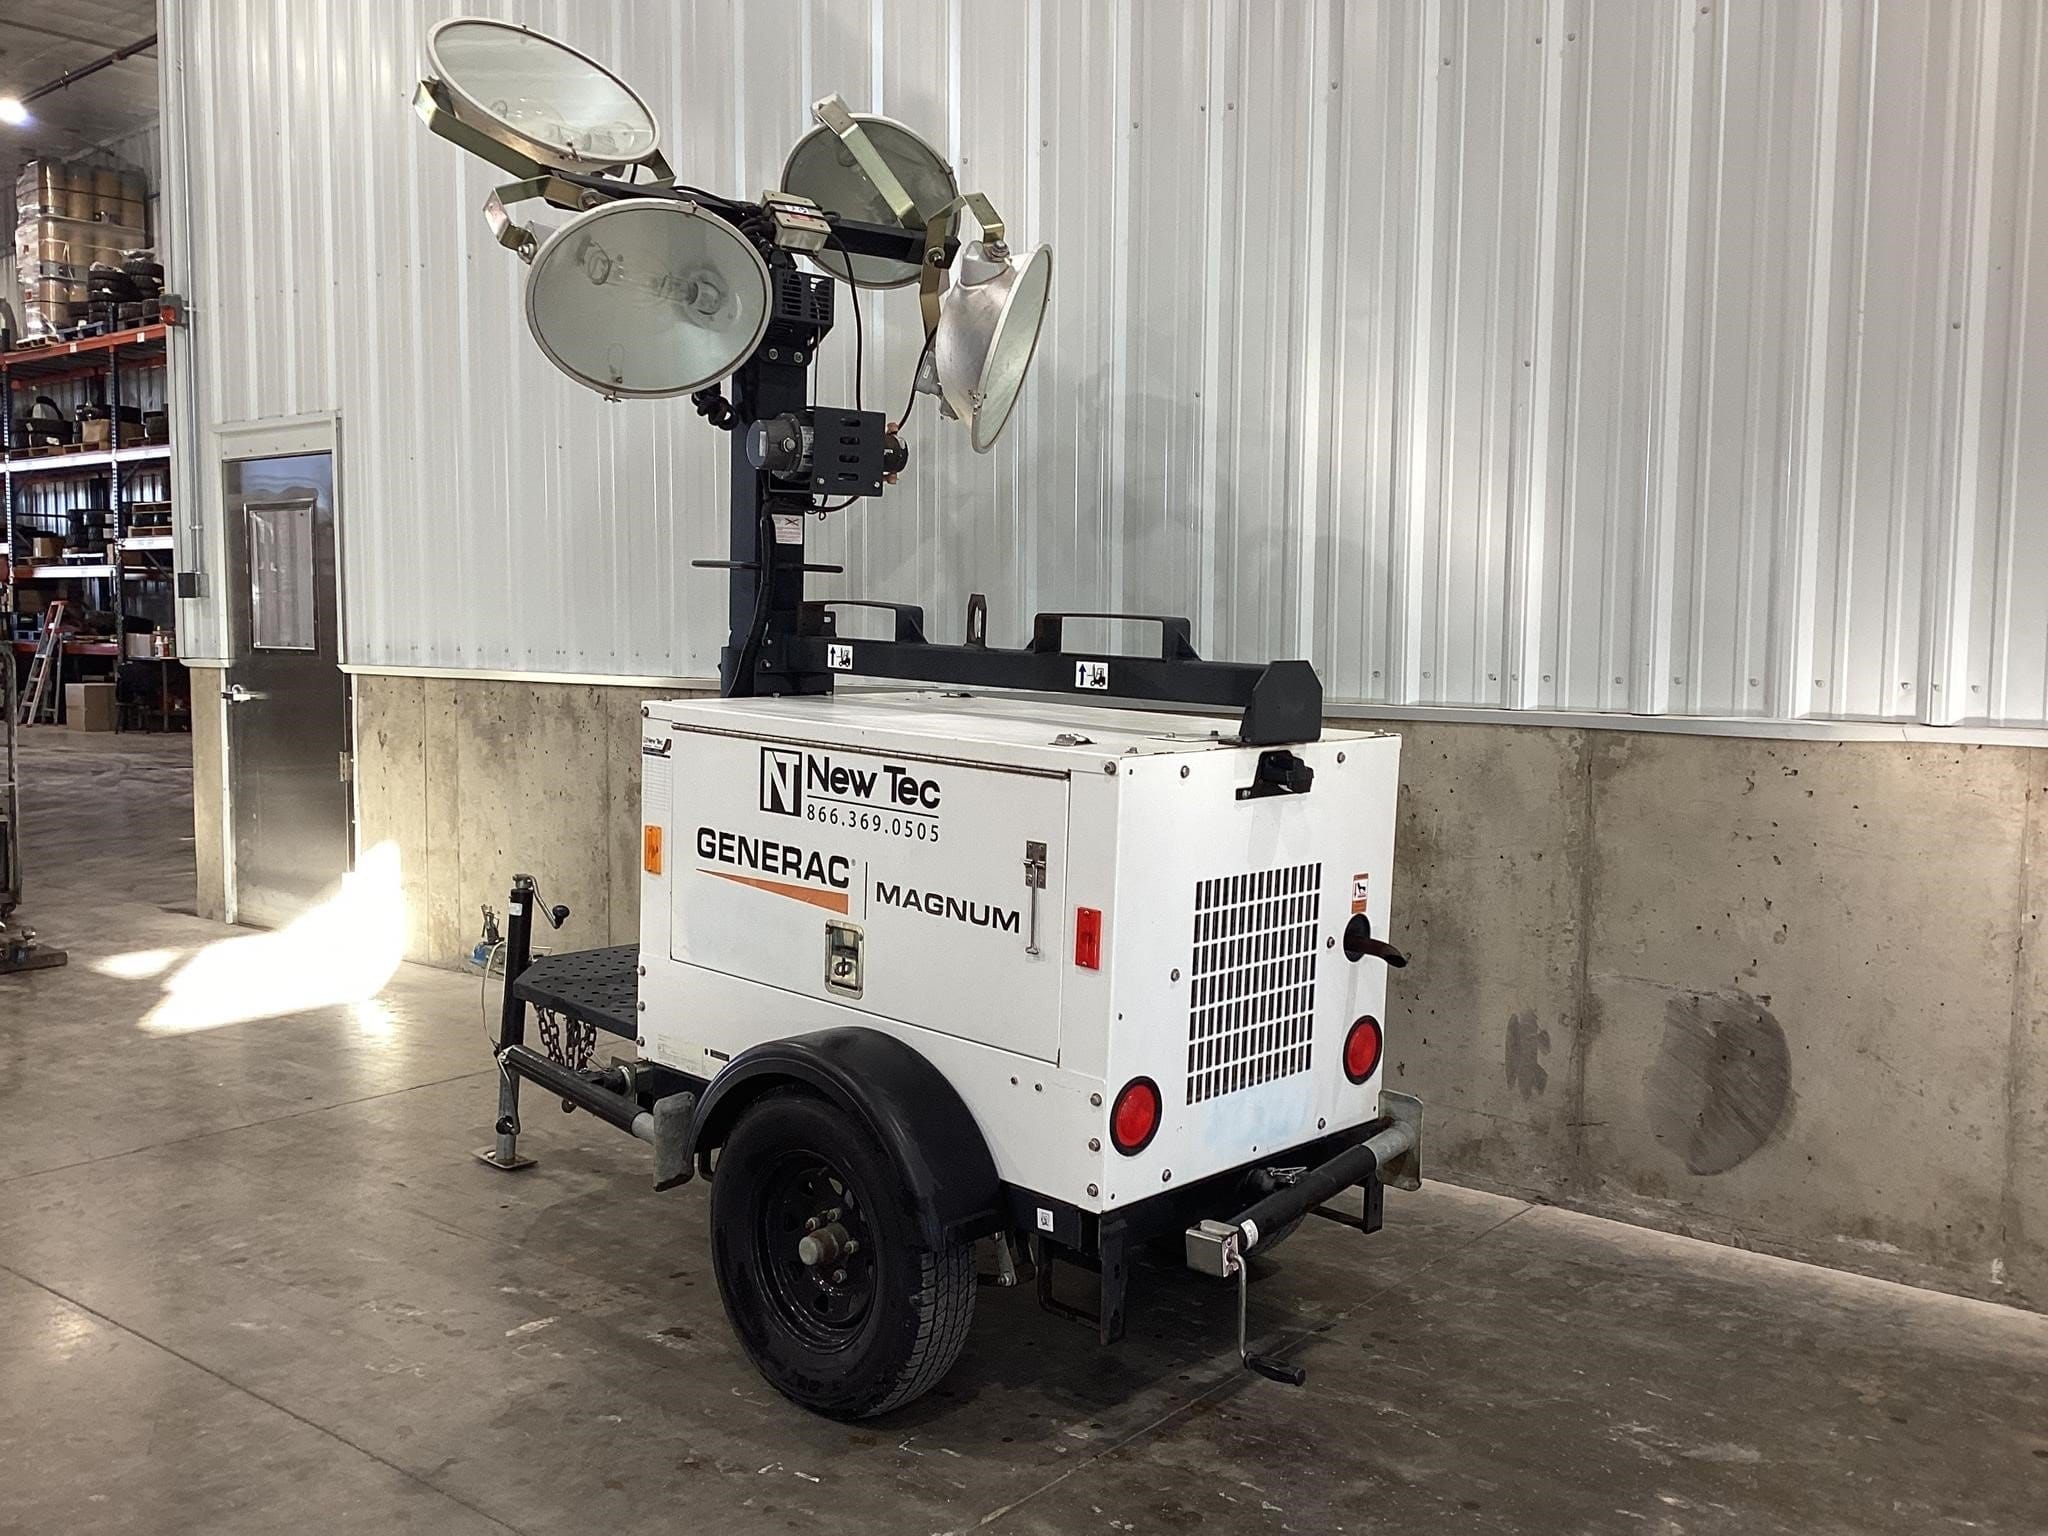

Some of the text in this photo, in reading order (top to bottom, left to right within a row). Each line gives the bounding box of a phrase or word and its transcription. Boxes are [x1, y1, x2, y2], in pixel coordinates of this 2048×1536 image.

[807, 754, 941, 809] New Tec
[807, 804, 939, 842] 866.369.0505
[697, 827, 849, 888] GENERAC
[876, 881, 1020, 933] MAGNUM
